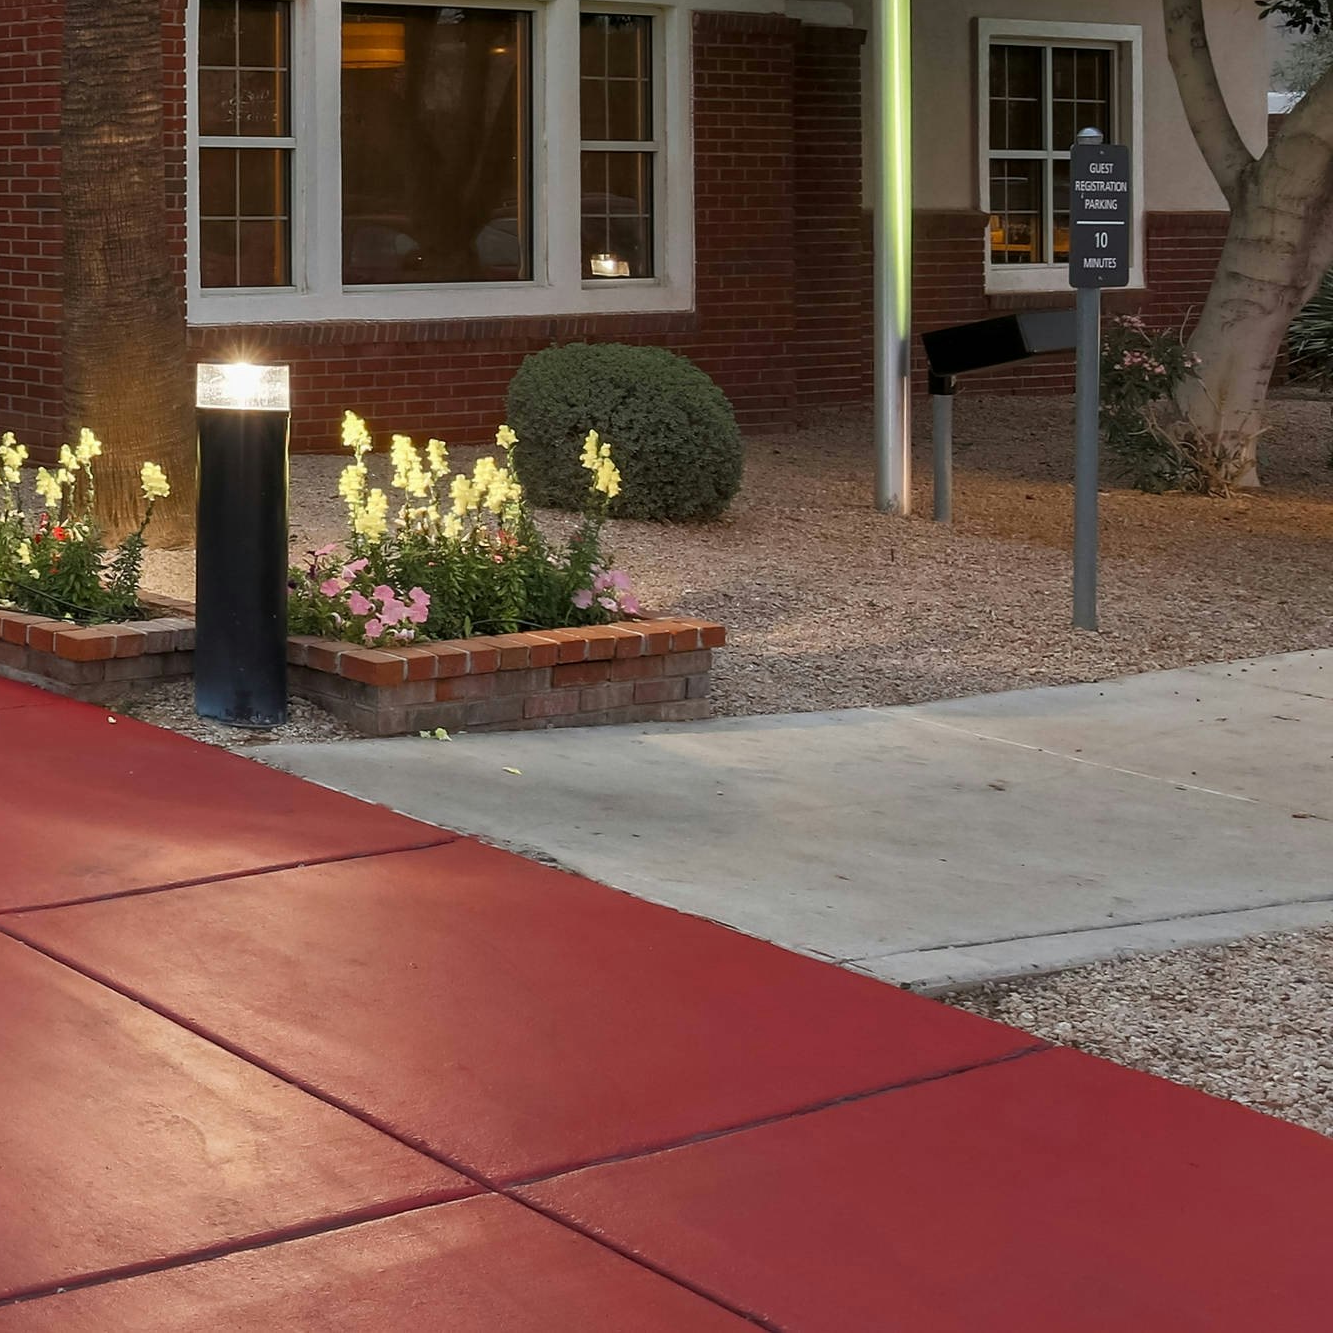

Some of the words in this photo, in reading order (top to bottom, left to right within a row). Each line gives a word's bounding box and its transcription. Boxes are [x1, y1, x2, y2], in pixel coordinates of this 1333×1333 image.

[1089, 163, 1114, 174] GUEST
[1075, 181, 1127, 192] REGISTRATION
[1084, 199, 1118, 210] PARKING
[1094, 232, 1108, 248] 10
[1083, 258, 1117, 268] MINUTES
